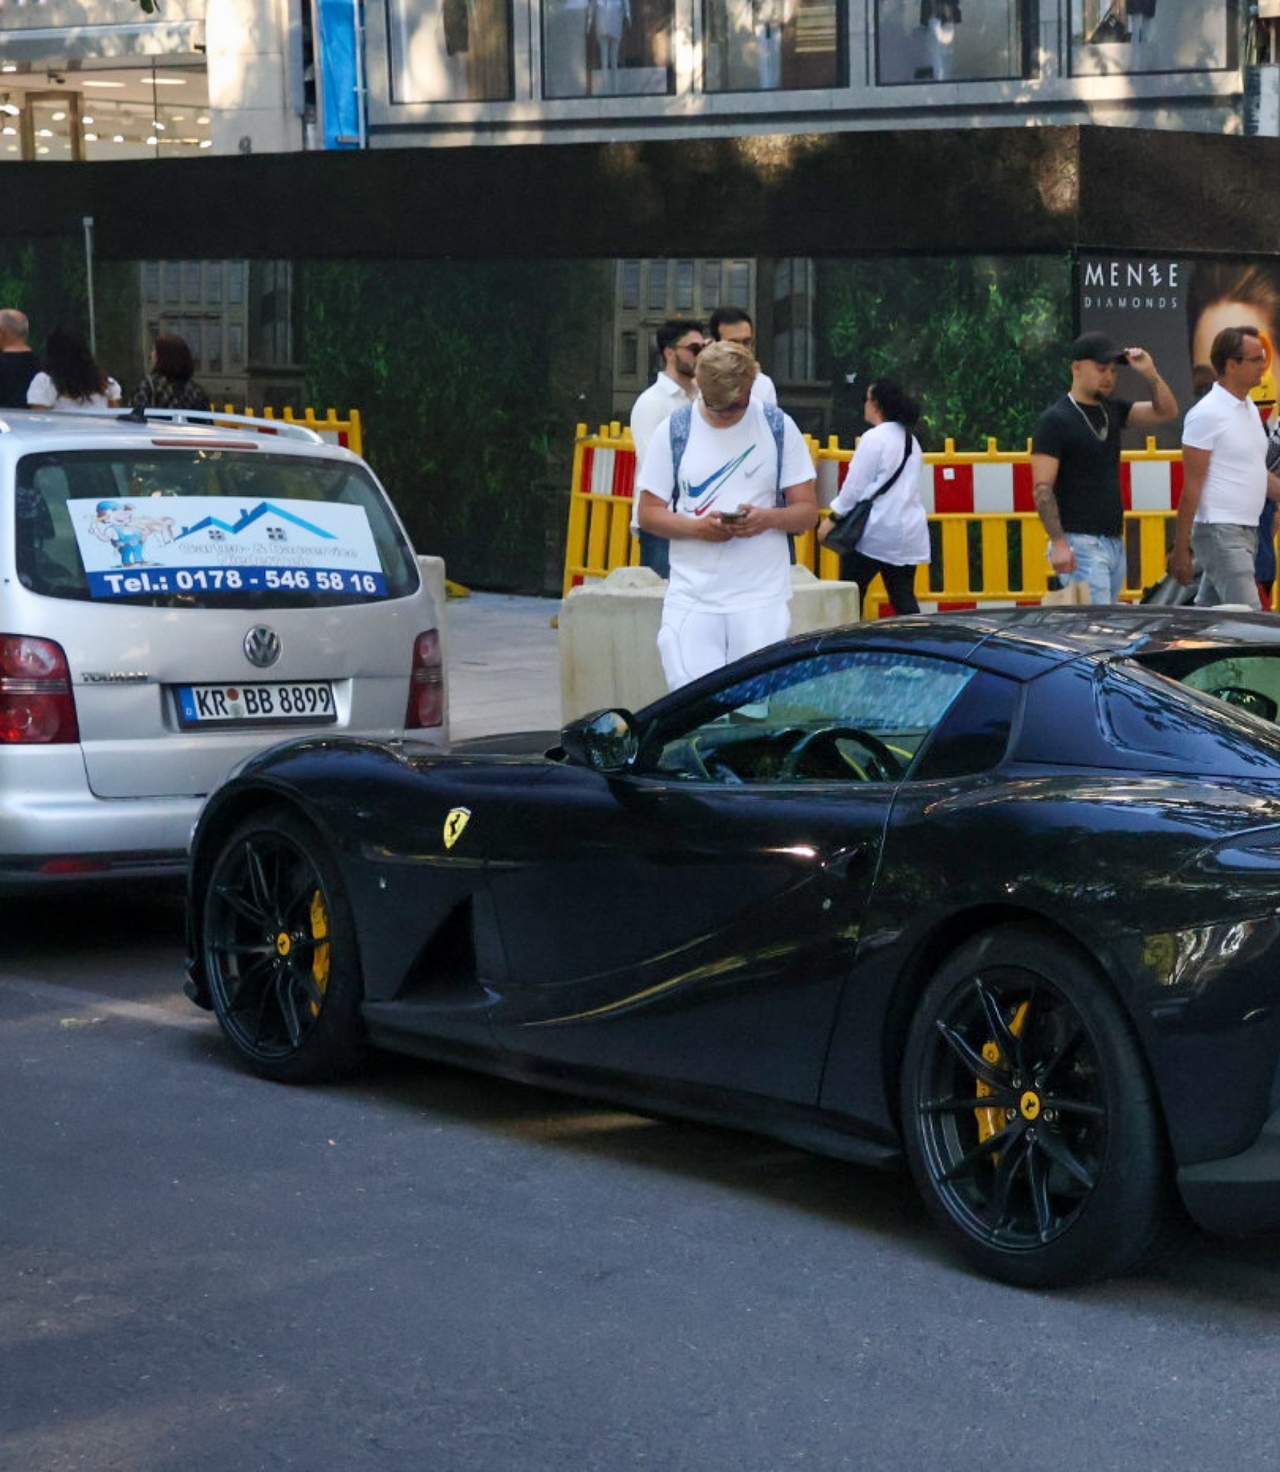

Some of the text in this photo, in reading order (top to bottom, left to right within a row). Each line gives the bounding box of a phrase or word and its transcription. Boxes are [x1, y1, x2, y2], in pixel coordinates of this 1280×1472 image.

[1084, 297, 1177, 309] DIAMONDS
[104, 574, 168, 594] Tel.:
[177, 570, 243, 590] 0178
[266, 570, 310, 589] 546
[316, 571, 344, 590] 58
[351, 573, 376, 593] 16
[197, 689, 229, 717] KR
[243, 688, 274, 715] BB
[278, 686, 332, 714] 8899
